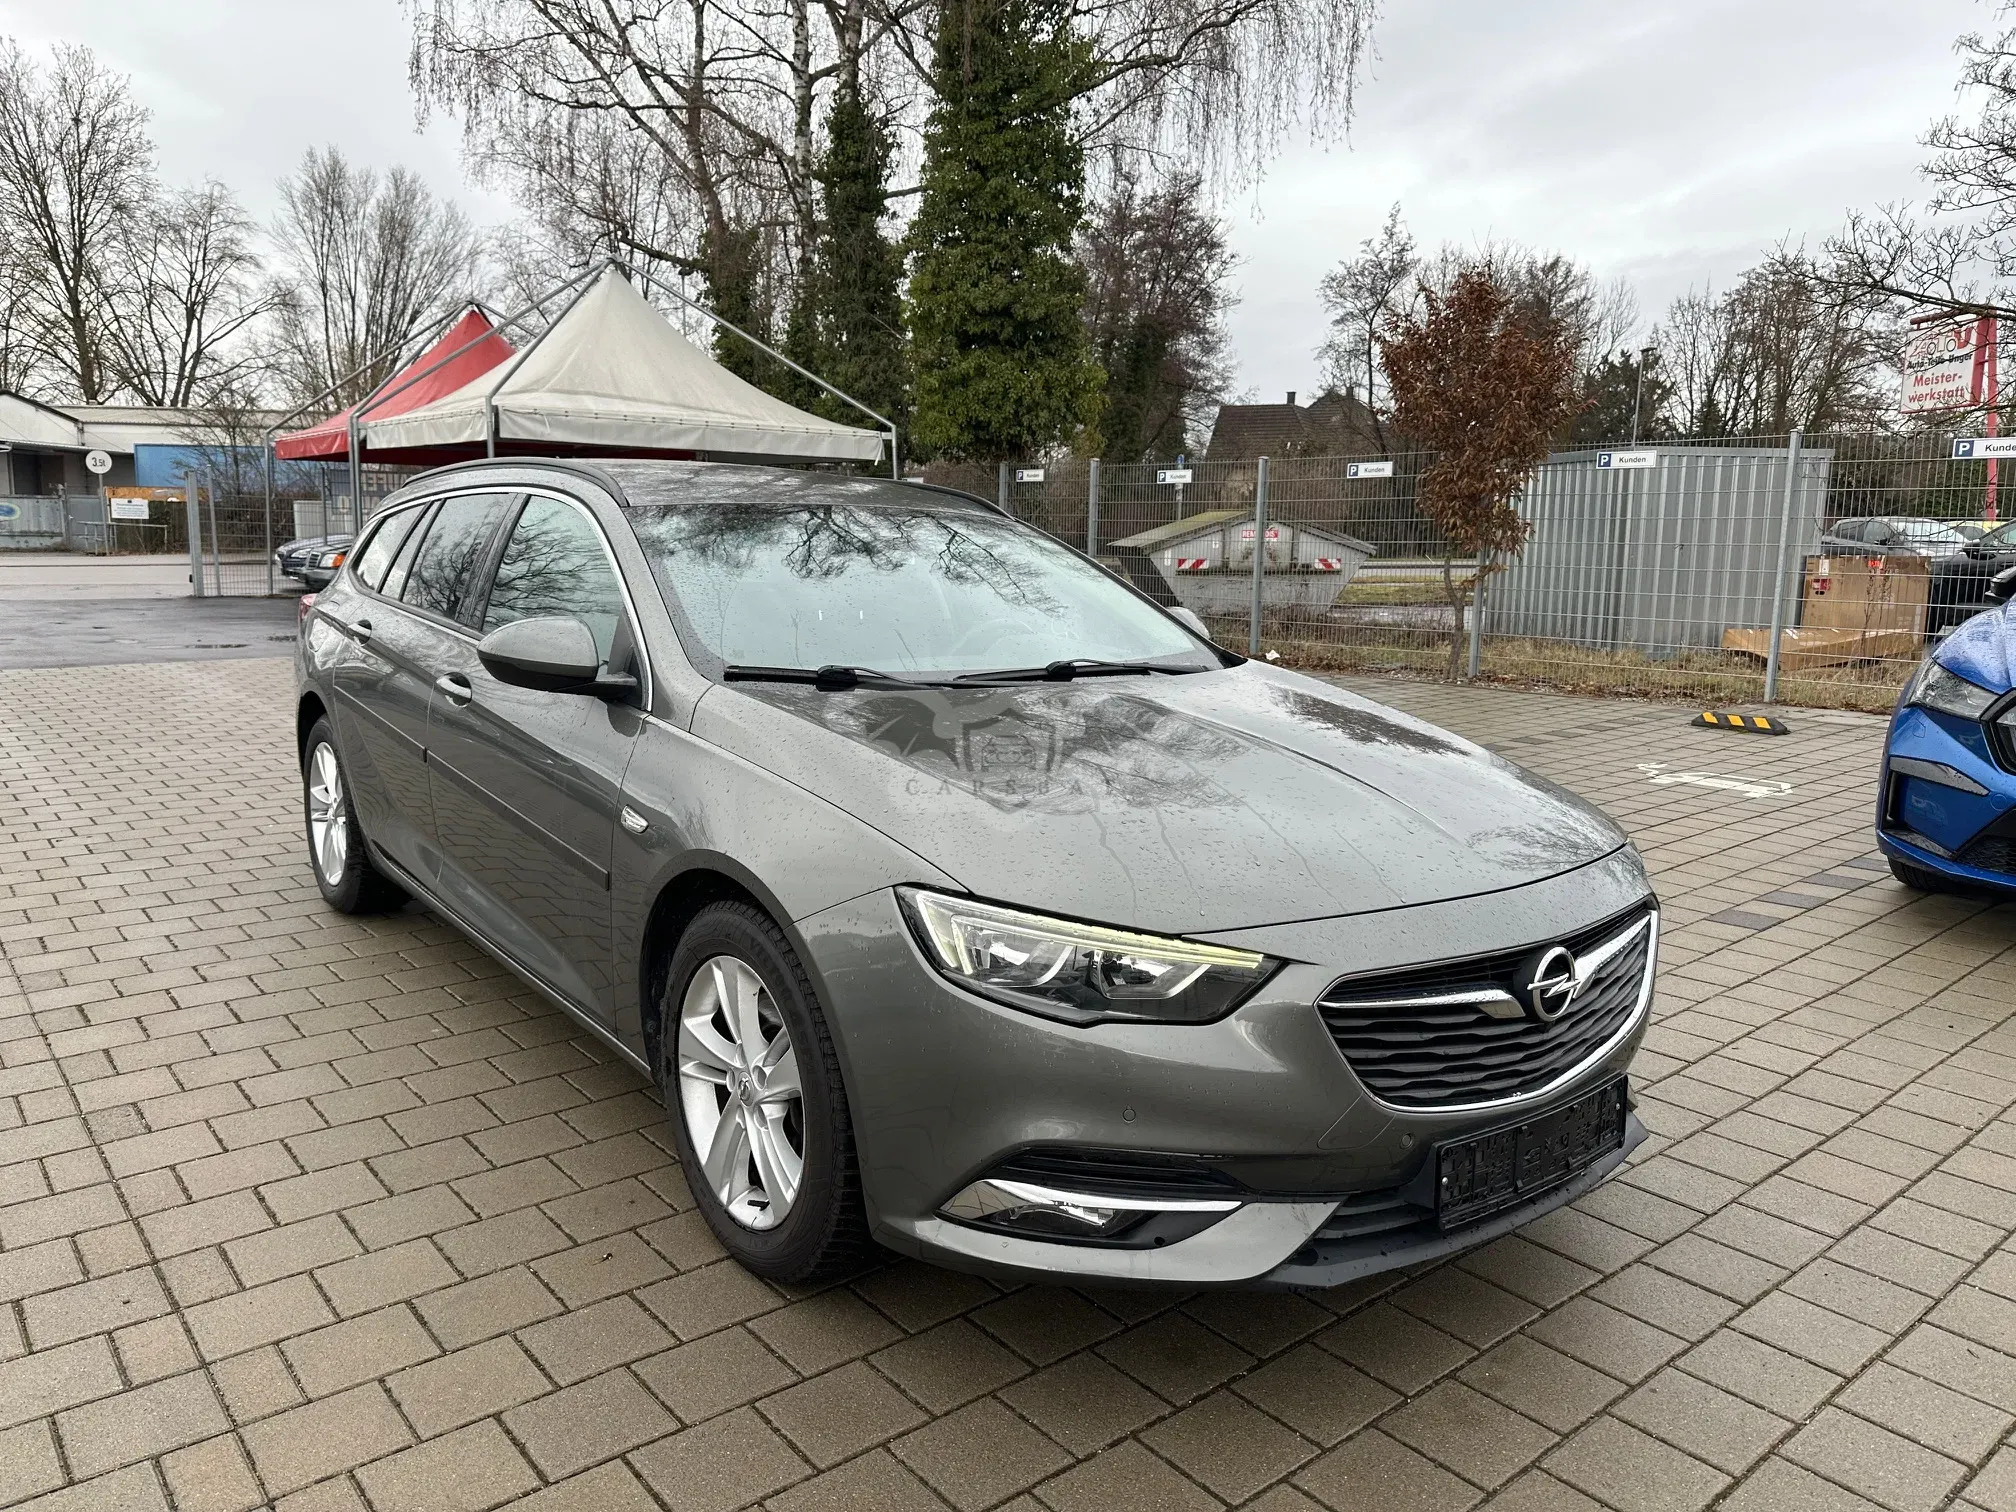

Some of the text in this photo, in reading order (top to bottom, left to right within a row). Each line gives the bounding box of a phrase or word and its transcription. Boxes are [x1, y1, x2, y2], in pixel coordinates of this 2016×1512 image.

[1913, 372, 1963, 387] Meister-
[1908, 385, 1964, 403] werkstatt
[1959, 442, 2016, 455] P Kunde
[1600, 455, 1609, 466] P
[1350, 466, 1357, 475] P
